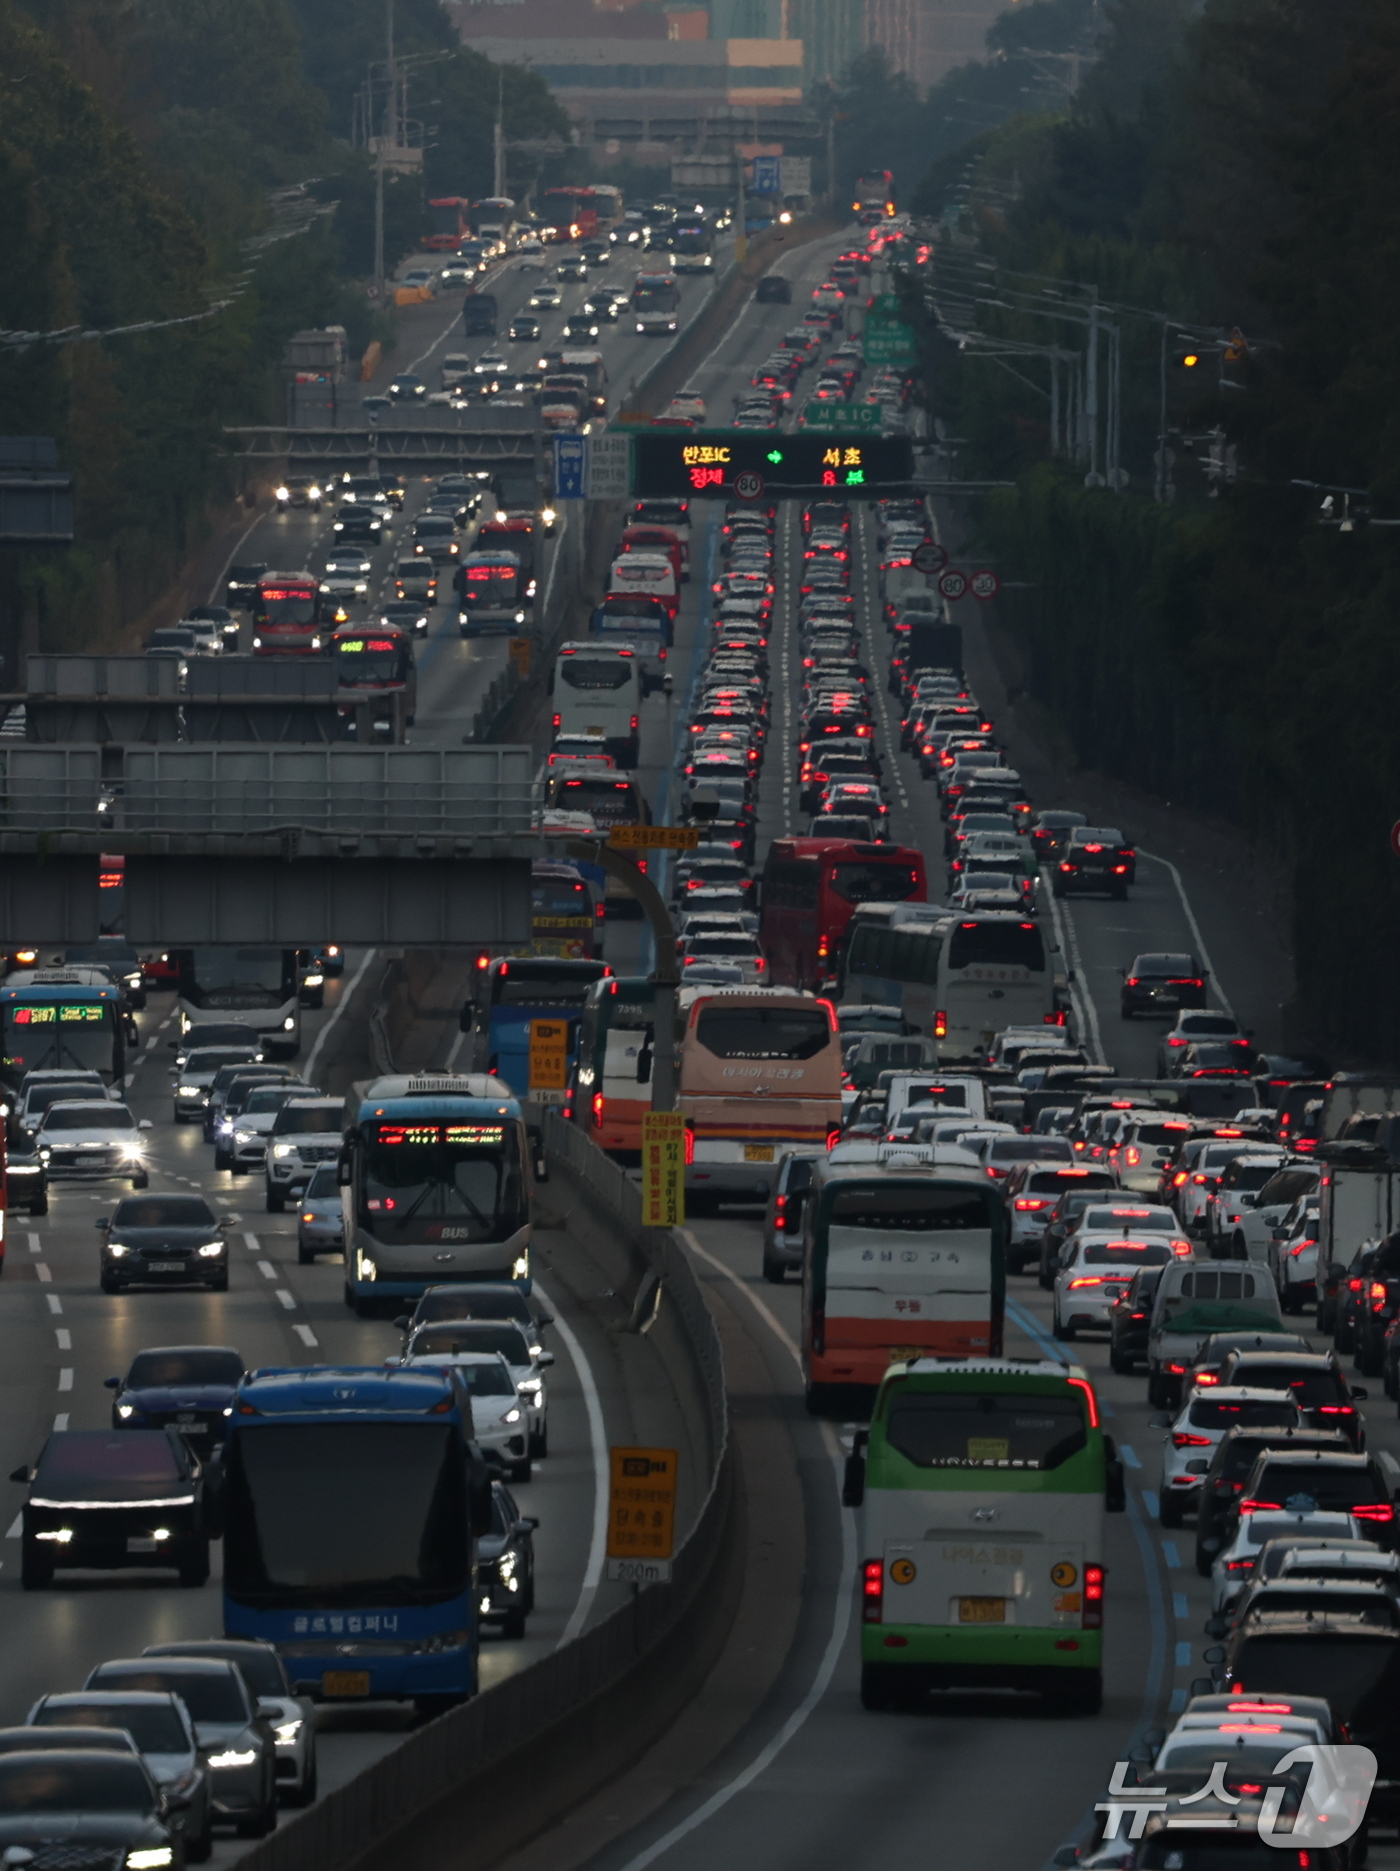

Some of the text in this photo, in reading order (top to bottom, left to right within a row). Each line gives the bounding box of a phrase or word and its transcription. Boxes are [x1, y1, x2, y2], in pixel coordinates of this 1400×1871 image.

[682, 446, 731, 465] 반포IC
[822, 446, 863, 467] 서초
[689, 467, 725, 488] 정체
[740, 478, 758, 492] 80
[943, 578, 963, 593] 80
[618, 1563, 659, 1579] 200m
